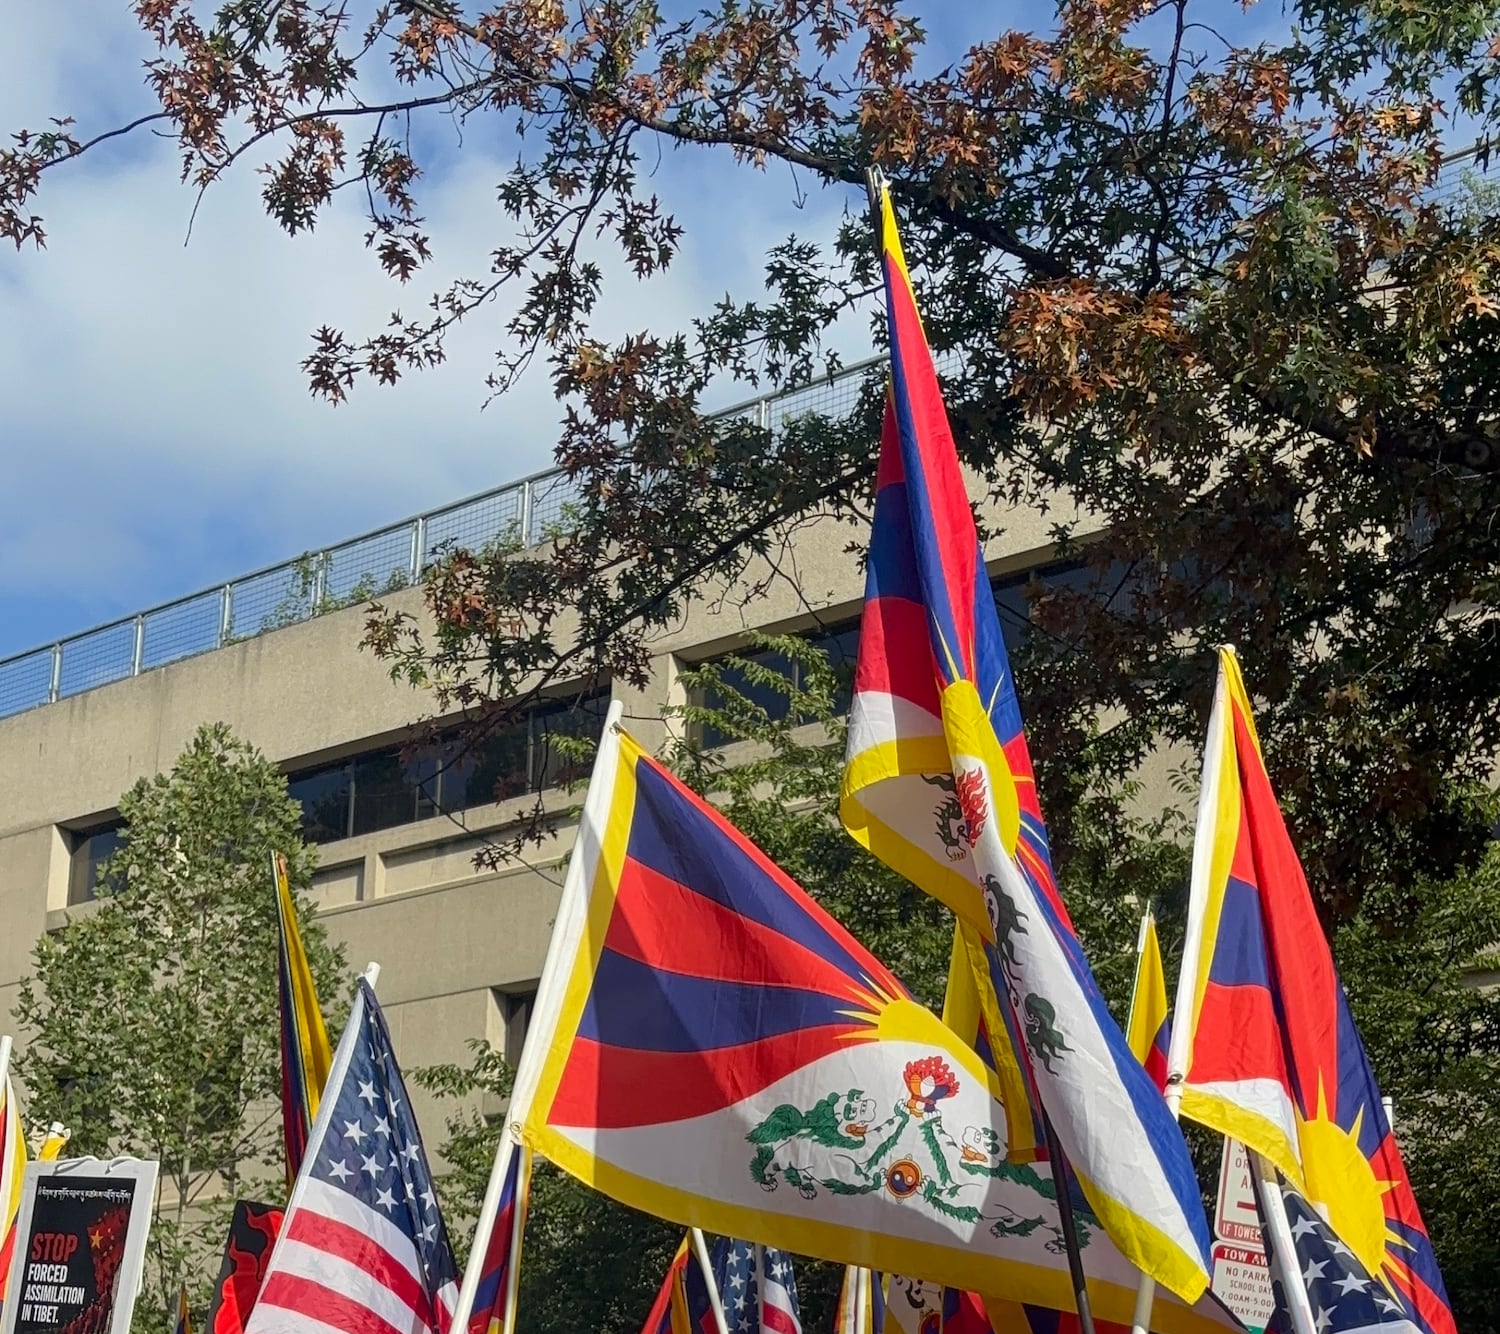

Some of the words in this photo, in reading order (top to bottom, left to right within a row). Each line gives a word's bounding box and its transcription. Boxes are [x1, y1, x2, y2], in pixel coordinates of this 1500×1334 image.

[1222, 1223, 1231, 1236] IF
[31, 1232, 79, 1263] STOP
[1223, 1247, 1248, 1263] TOW
[27, 1263, 68, 1284] FORCED
[1225, 1266, 1239, 1278] NO
[24, 1284, 85, 1305] ASSIMILATION
[1230, 1279, 1256, 1293] SCHOOL
[21, 1303, 32, 1321] IN
[33, 1305, 59, 1324] TIBET.
